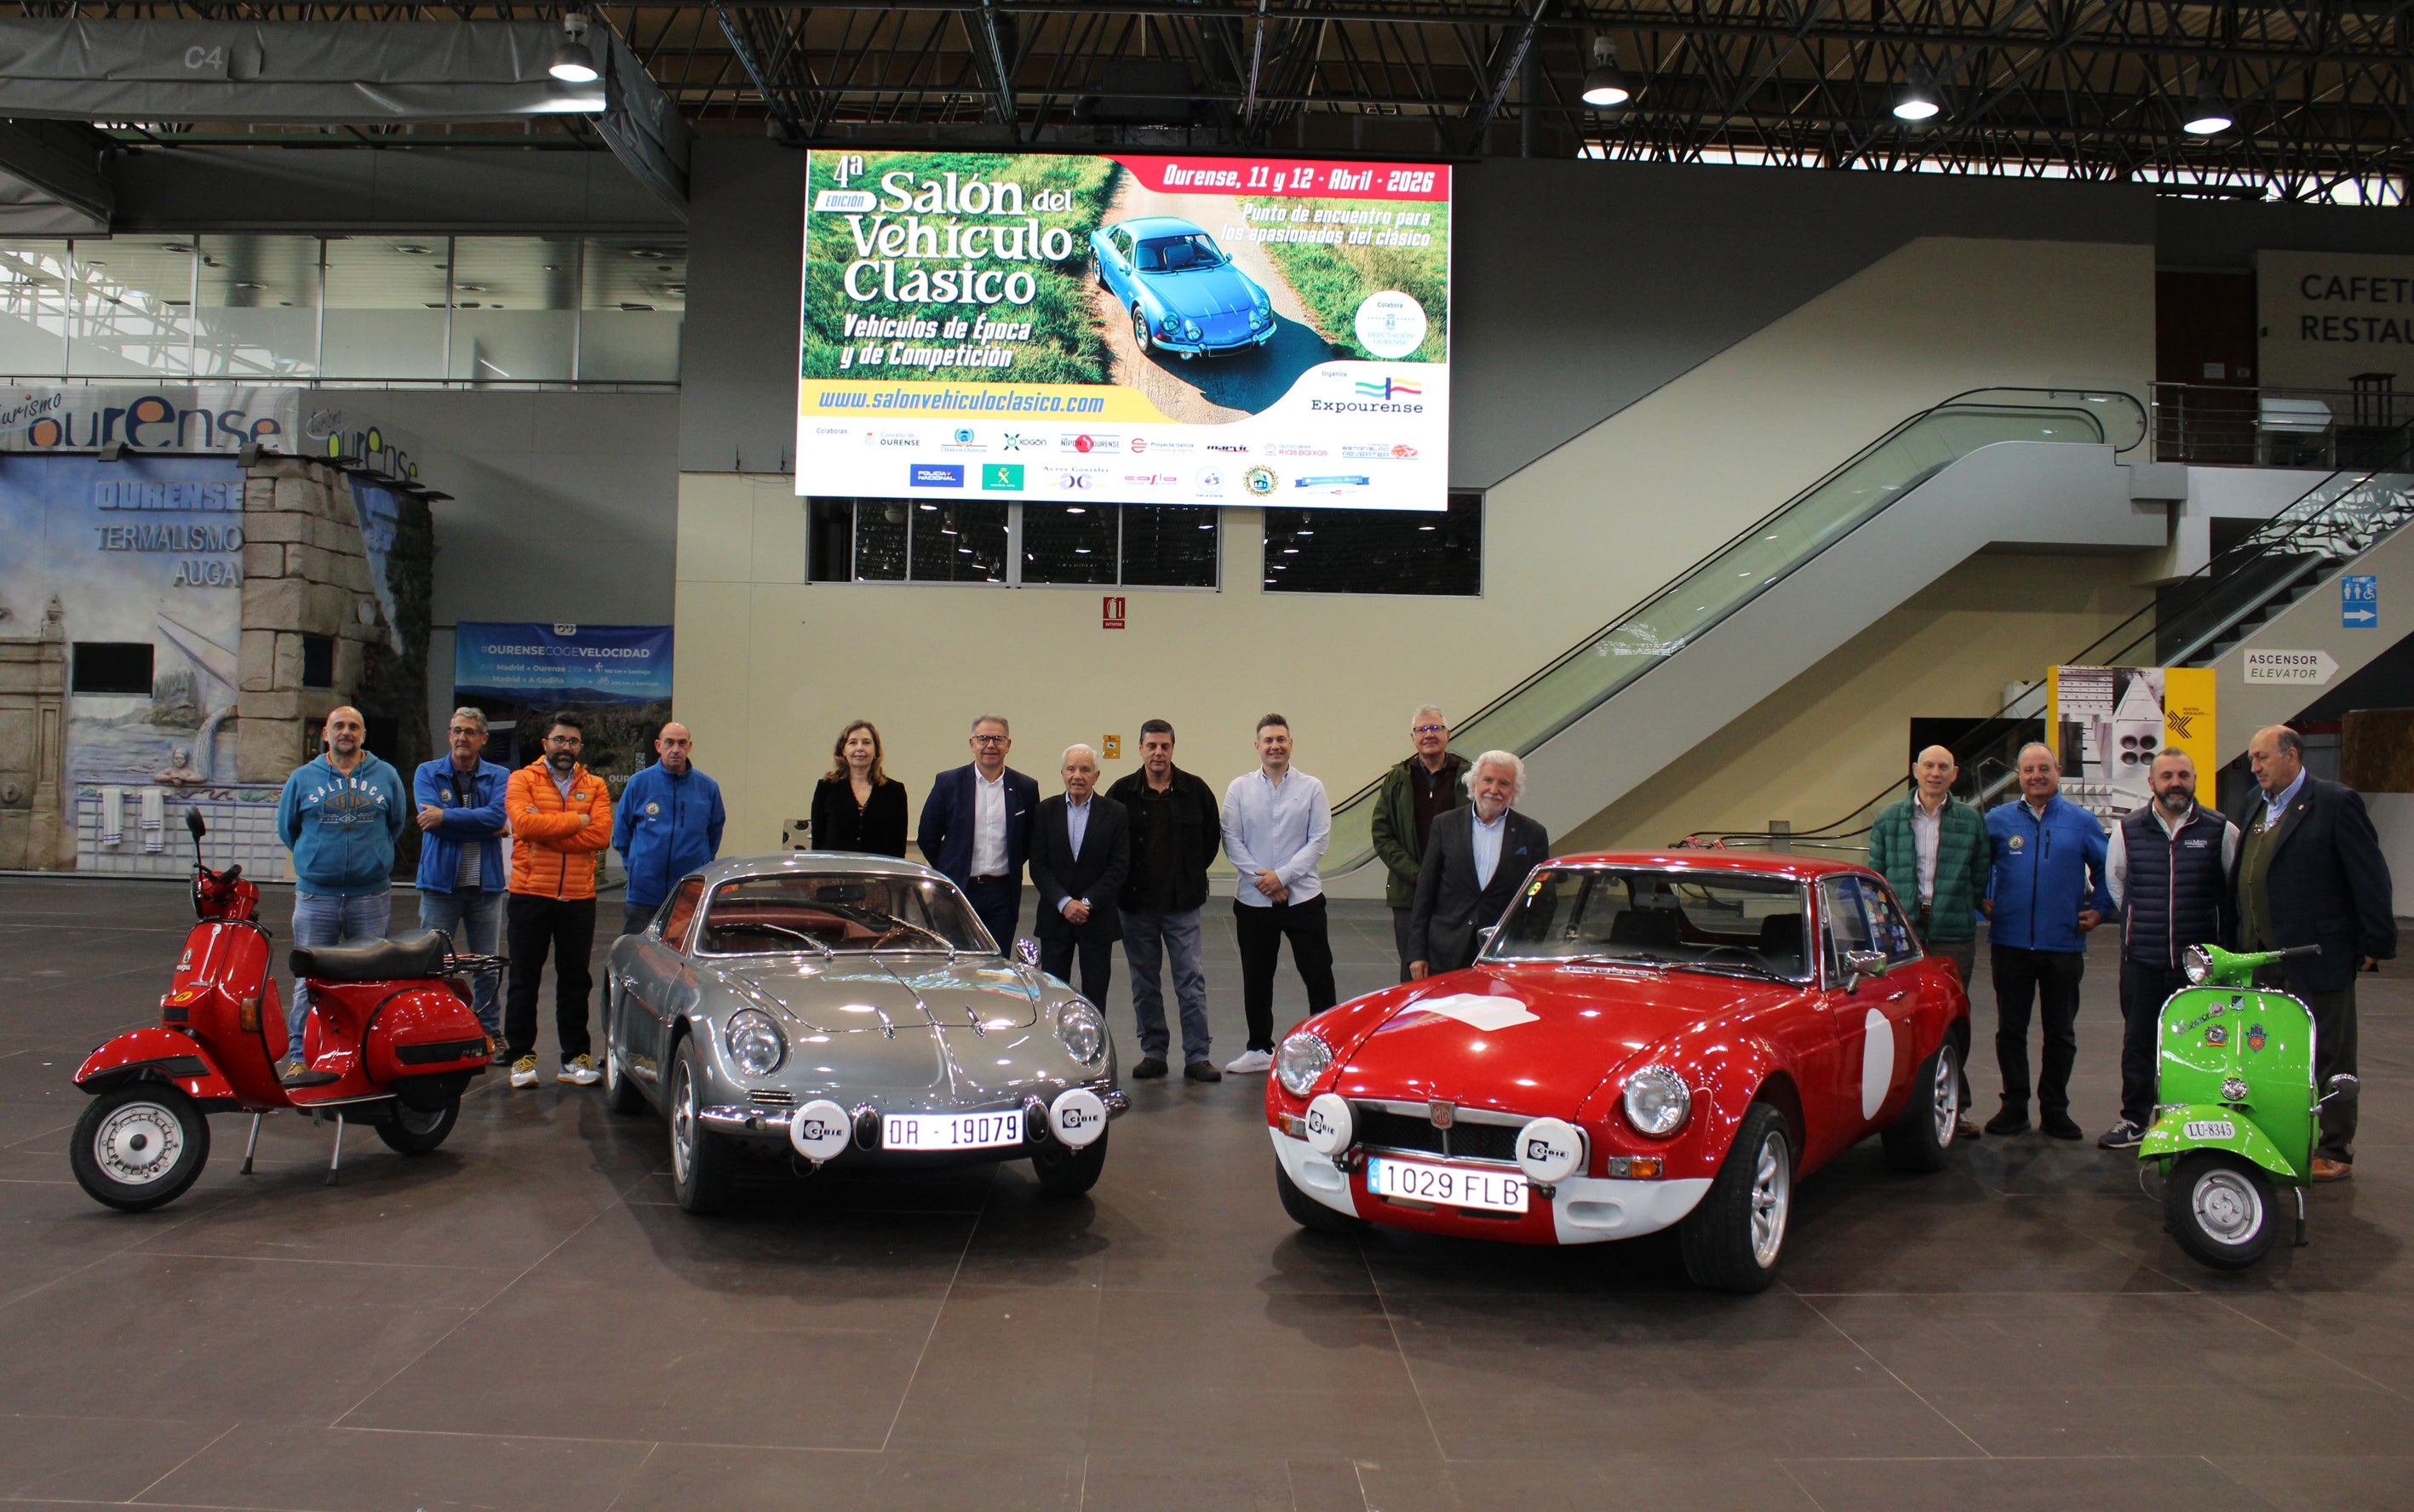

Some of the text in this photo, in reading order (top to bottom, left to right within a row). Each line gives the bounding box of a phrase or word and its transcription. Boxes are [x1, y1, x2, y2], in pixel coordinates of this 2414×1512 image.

[184, 45, 222, 70] C4
[1163, 164, 1241, 190] Ourense,
[1247, 167, 1270, 187] 11
[1273, 173, 1286, 192] y
[1289, 168, 1315, 189] 12
[1328, 169, 1372, 191] Abril
[1387, 170, 1436, 193] 2026
[825, 194, 865, 208] EDICIÓN
[880, 171, 1073, 215] Salón del
[1241, 203, 1431, 228] Punto de encuentro para
[845, 215, 1073, 261] Vehículo
[1221, 223, 1431, 247] los apasionados del clásico
[843, 260, 1036, 304] Clásico
[2301, 274, 2414, 303] CAFET
[843, 312, 1032, 346] Vehículos de Época
[840, 342, 1013, 371] y de Competición
[0, 392, 61, 424] urismo
[818, 388, 1104, 413] www.salonvehiculoclasico.com
[1311, 399, 1424, 413] Expourense
[95, 481, 245, 511] OURENSE
[95, 525, 244, 553] TERMALISMO
[174, 561, 240, 587] AUGA
[2249, 655, 2318, 666] ASCENSOR
[2251, 668, 2317, 679] ELEVATOR
[890, 1120, 918, 1144] OR
[951, 1115, 1017, 1144] 19079
[2188, 1124, 2232, 1137] LU-8345
[1387, 1165, 1519, 1206] 1029 FLB
